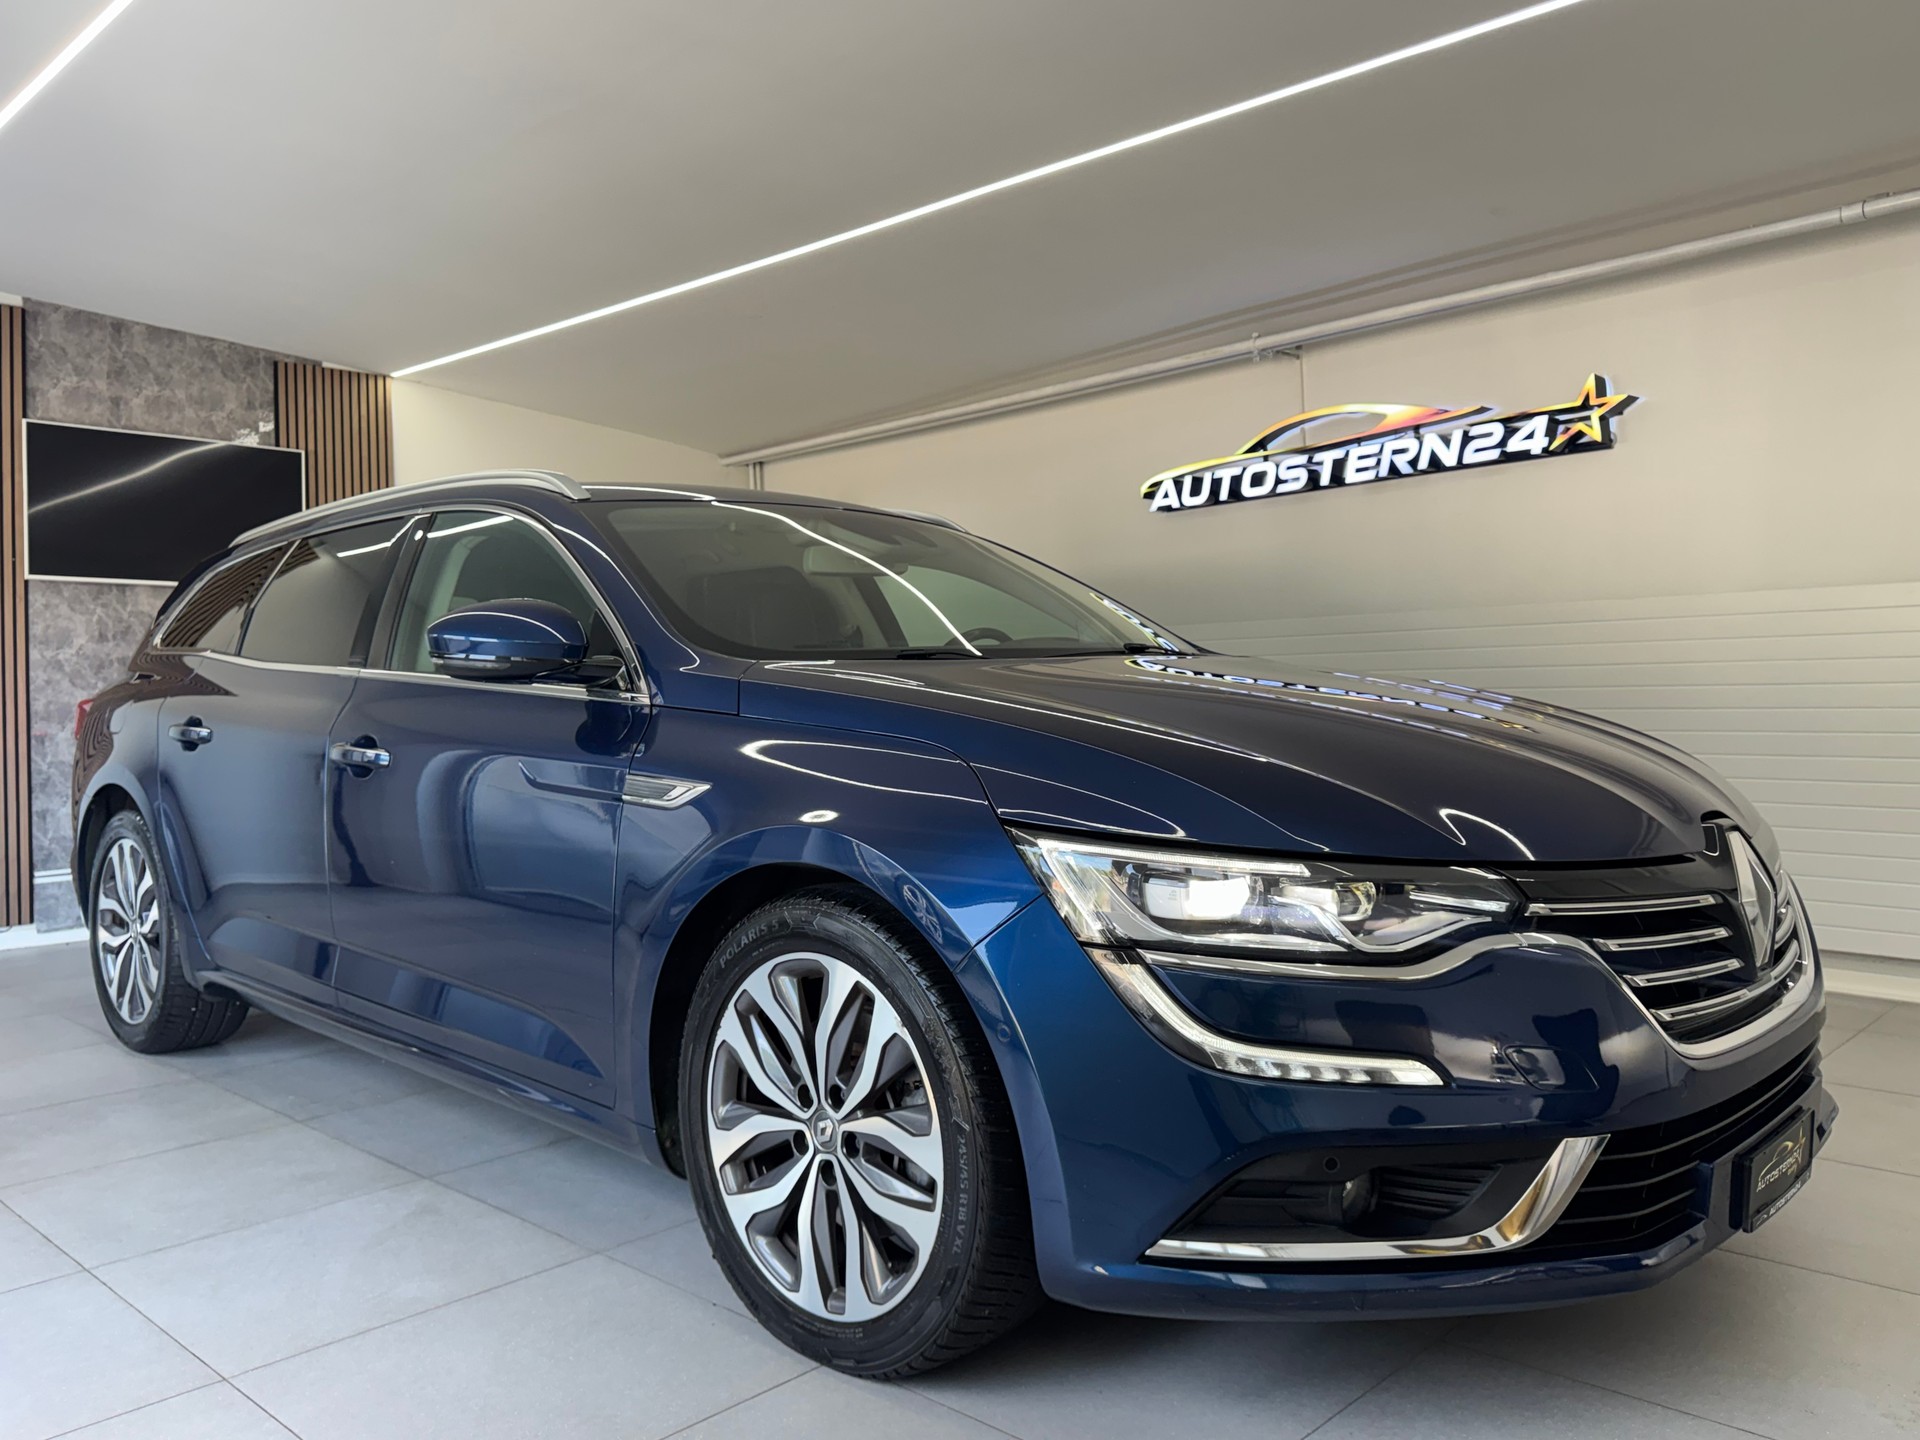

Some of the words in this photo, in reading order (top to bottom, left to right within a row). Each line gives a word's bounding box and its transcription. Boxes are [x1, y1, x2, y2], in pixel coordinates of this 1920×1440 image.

[1148, 414, 1550, 513] AUTOSTERN24
[719, 923, 768, 969] POLARIS
[957, 1134, 969, 1190] 245/45
[958, 1193, 969, 1221] R18
